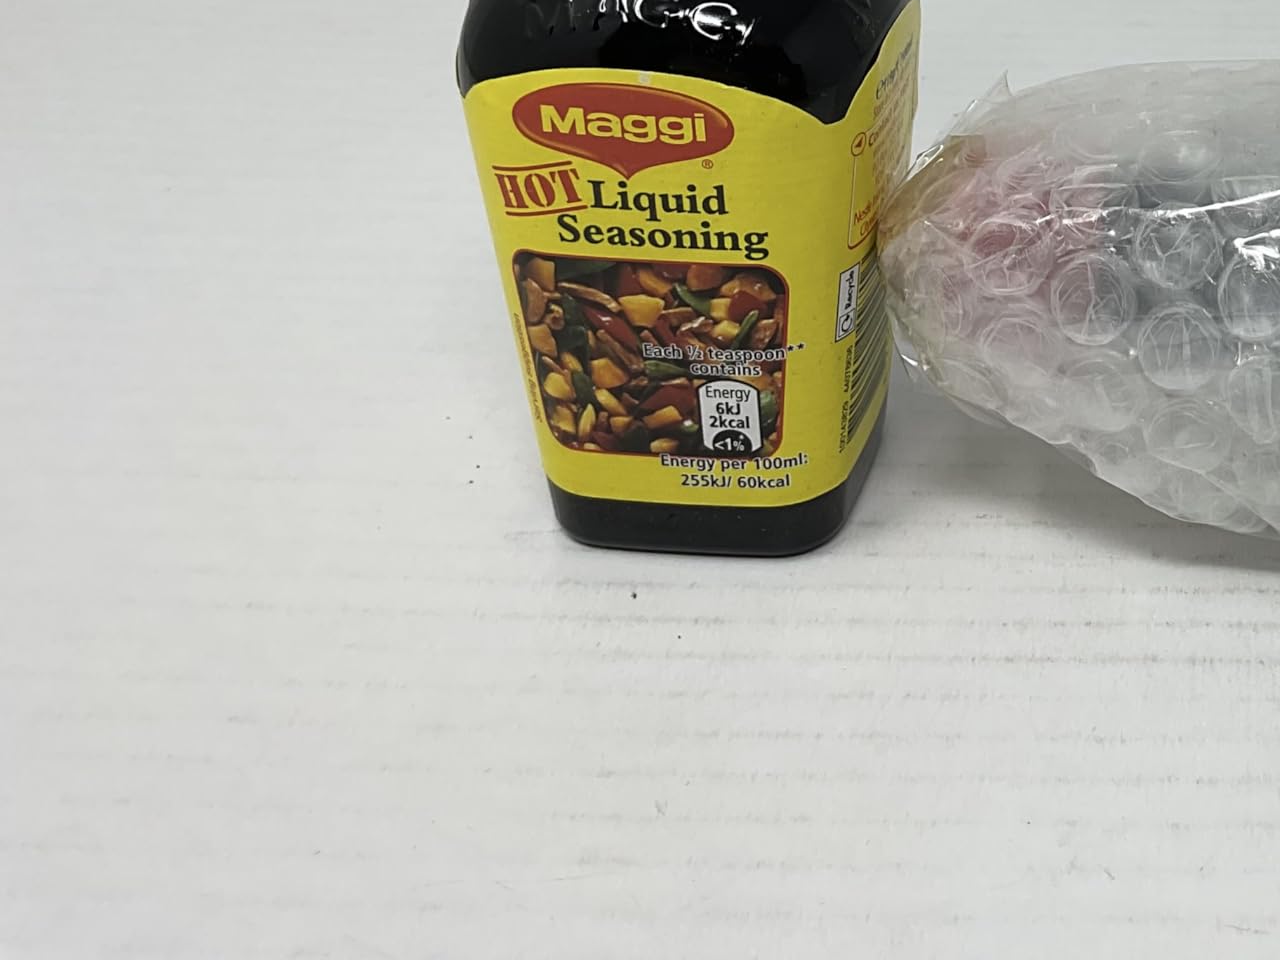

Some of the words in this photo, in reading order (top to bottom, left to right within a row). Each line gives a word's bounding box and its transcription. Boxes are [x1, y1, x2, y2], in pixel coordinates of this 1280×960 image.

[540, 104, 707, 145] Maggi
[494, 168, 582, 208] HOT
[587, 180, 729, 222] Liquid
[557, 213, 769, 261] Seasoning
[844, 270, 856, 310] Recycle
[643, 343, 683, 359] Each
[690, 362, 762, 376] contains
[705, 385, 751, 402] Energy
[716, 401, 741, 415] 6kJ
[709, 415, 750, 429] 2kcal
[660, 453, 715, 471] Energy
[720, 457, 747, 472] per
[753, 451, 808, 470] 100ml:
[737, 473, 791, 489] 60kcal
